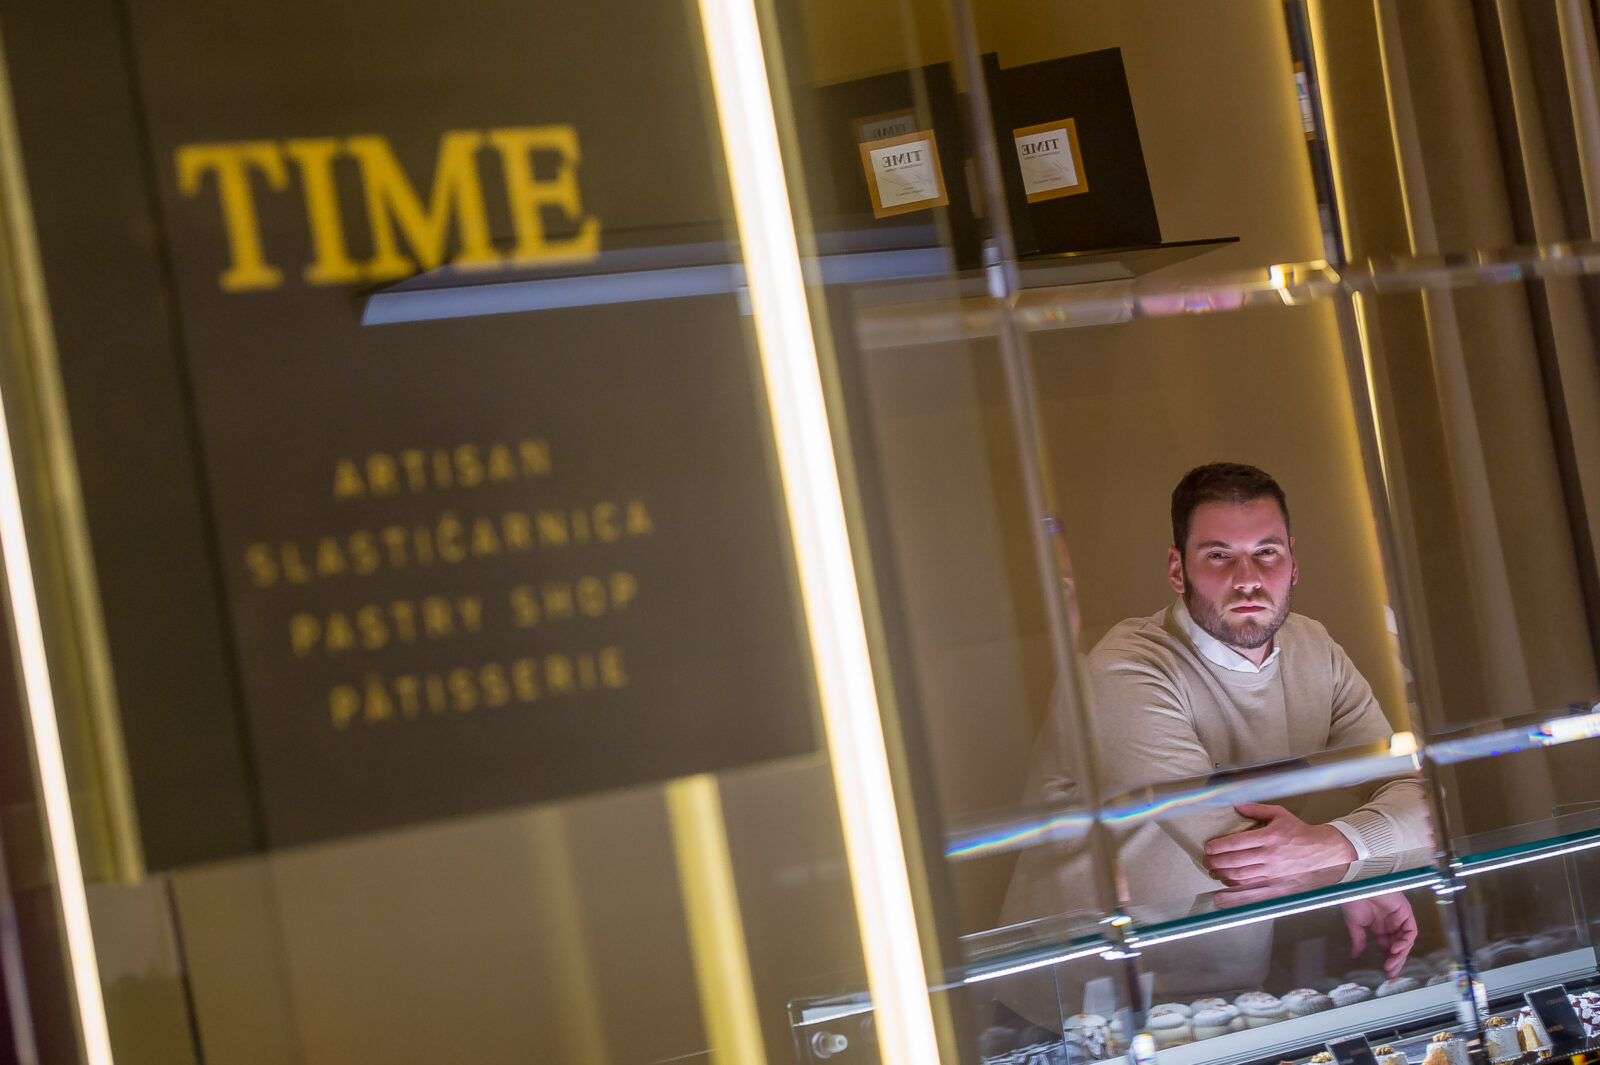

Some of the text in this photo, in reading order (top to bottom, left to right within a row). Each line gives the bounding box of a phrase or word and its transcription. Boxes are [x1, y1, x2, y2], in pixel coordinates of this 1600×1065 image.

[175, 124, 600, 292] TIME
[333, 437, 552, 500] ARTISAN
[246, 500, 654, 588] SLASTIČARNICA
[289, 571, 638, 657] PASTRY SHOP
